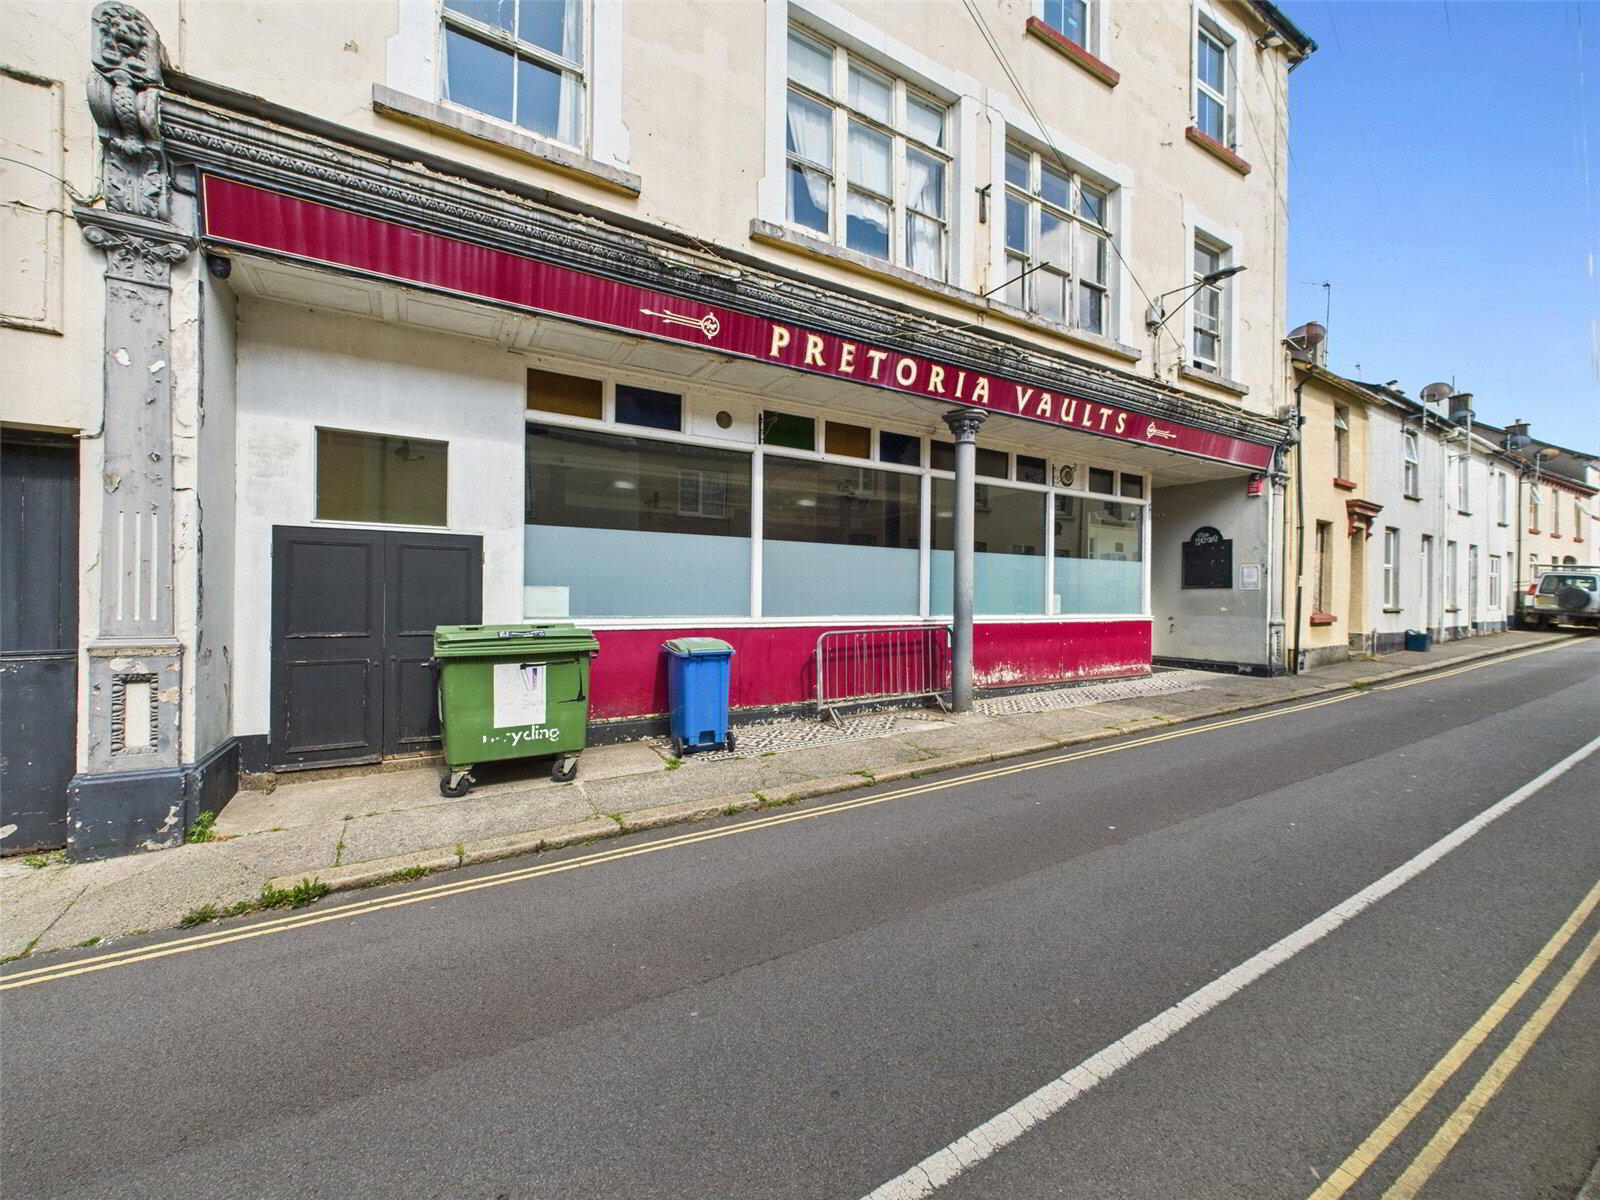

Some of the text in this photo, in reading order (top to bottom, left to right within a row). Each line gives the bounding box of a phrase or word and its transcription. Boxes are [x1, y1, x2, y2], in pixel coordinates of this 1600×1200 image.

[769, 325, 1128, 434] PRETORIA VAULTS
[482, 724, 560, 746] ycling
